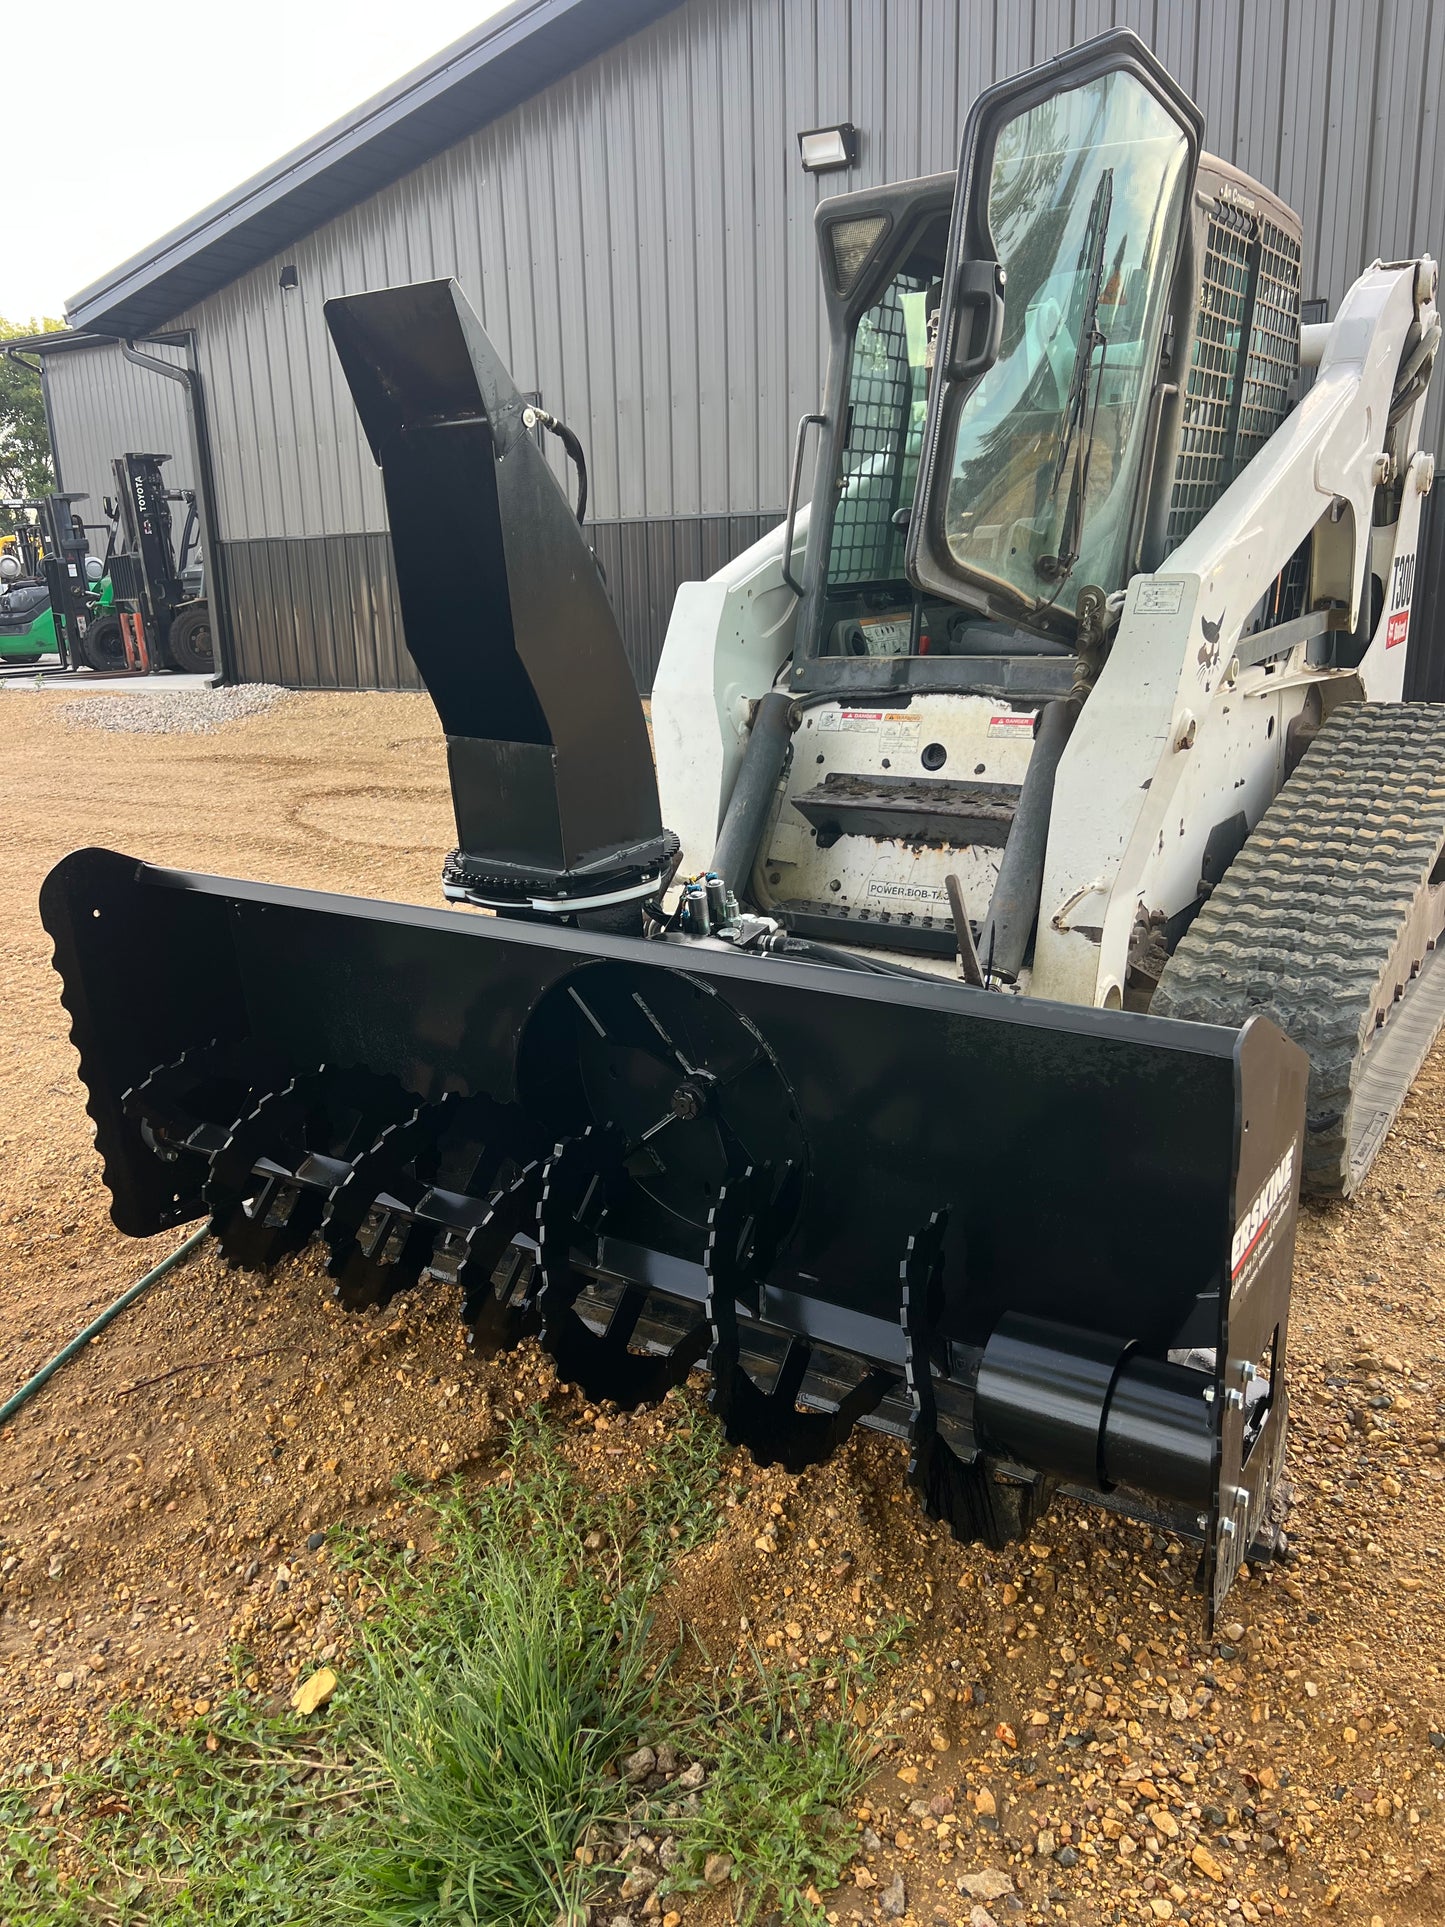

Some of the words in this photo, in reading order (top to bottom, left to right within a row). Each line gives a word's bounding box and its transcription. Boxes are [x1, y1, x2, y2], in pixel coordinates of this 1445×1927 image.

[134, 475, 147, 512] TOYOTA
[1391, 554, 1415, 611] T300
[907, 888, 951, 901] BOB-TAC
[1231, 1145, 1294, 1271] ERSKINE
